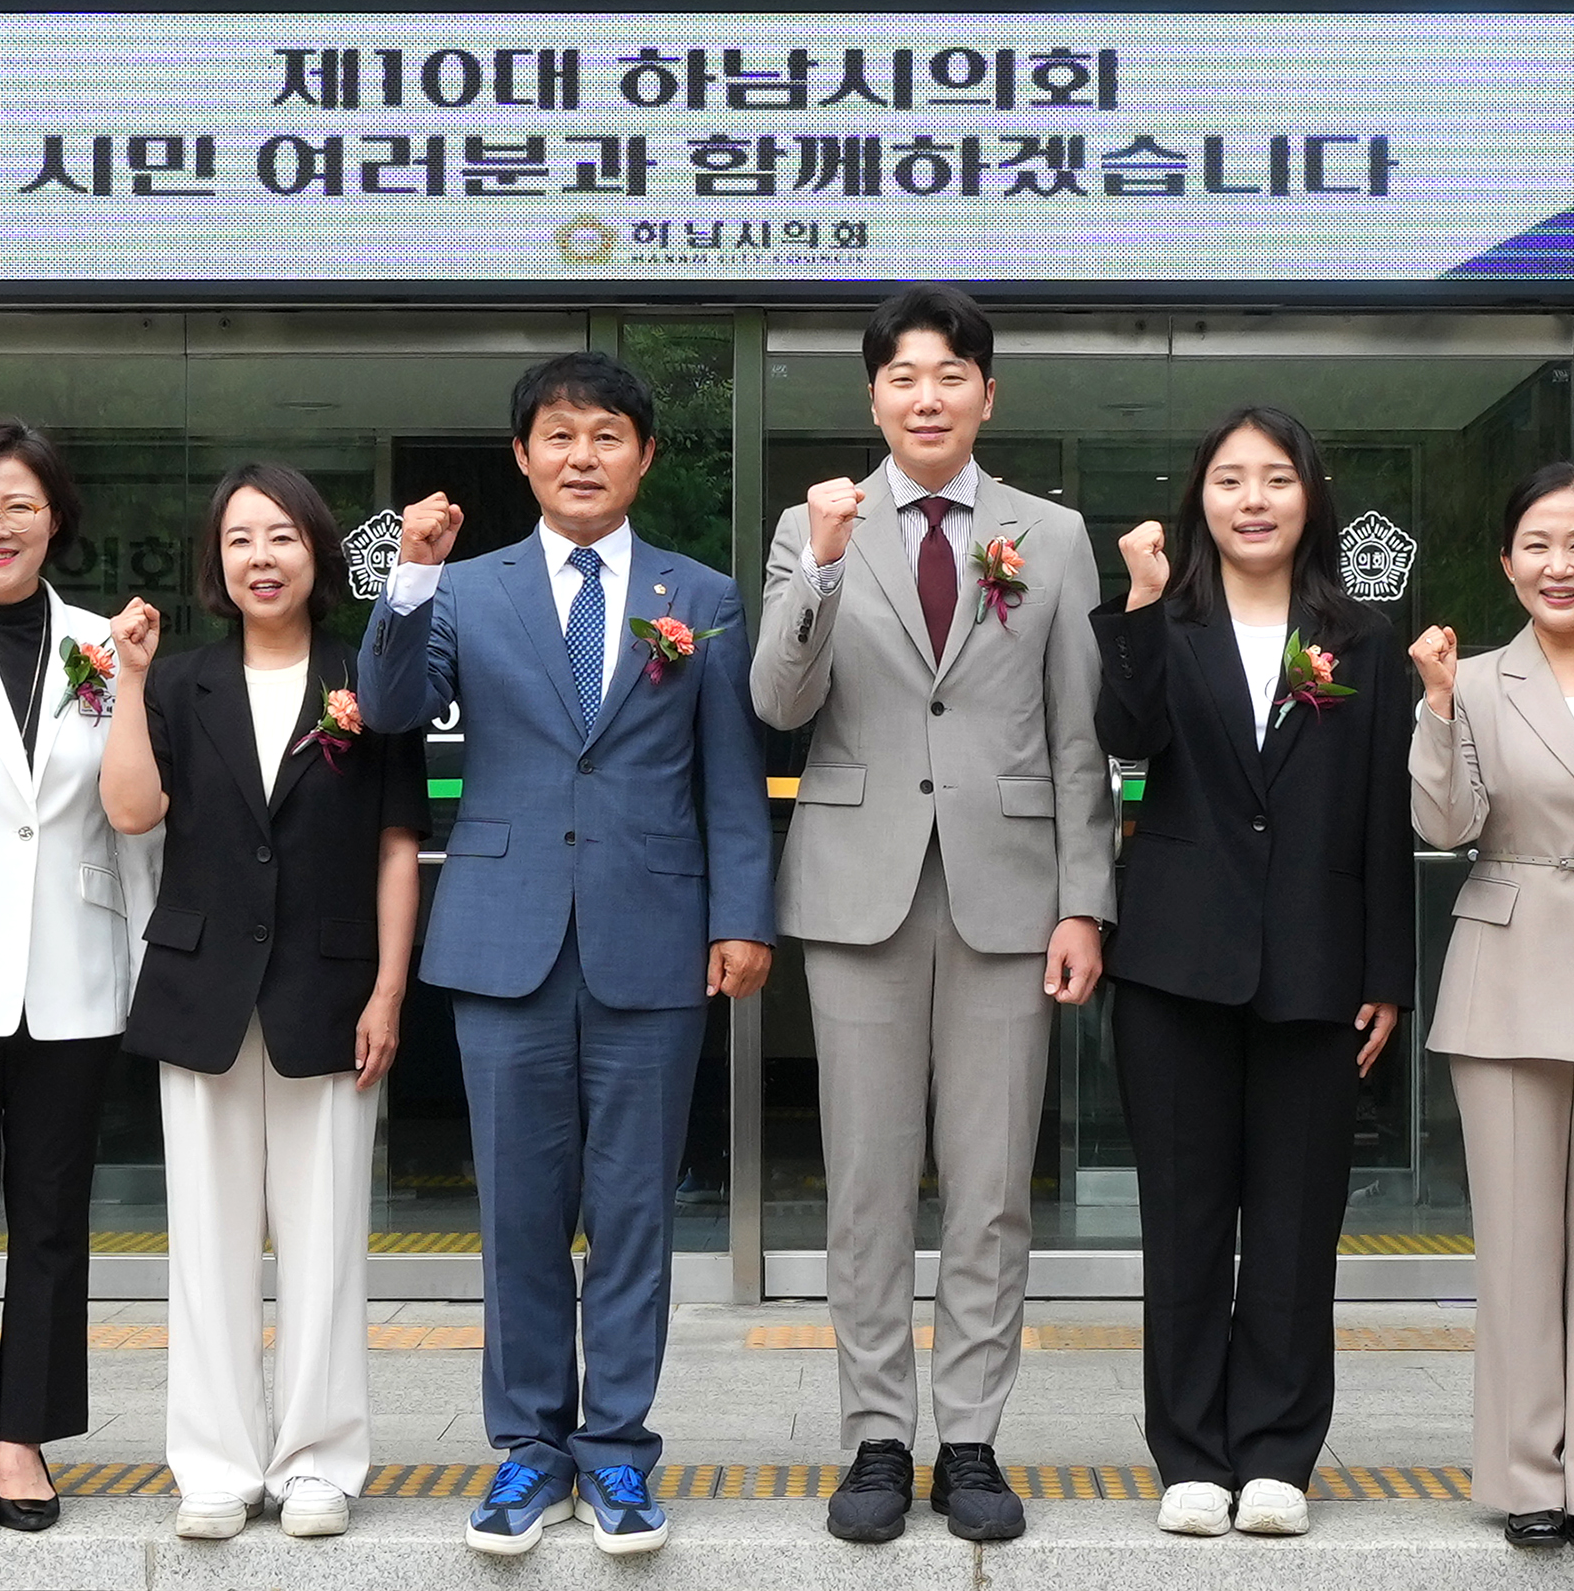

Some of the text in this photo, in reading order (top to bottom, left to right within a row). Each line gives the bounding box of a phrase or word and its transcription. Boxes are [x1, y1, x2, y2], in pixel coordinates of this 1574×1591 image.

[276, 47, 1115, 110] 제10대 하남시의회
[22, 132, 1397, 197] 시민 여러분과 함께하겠습니다
[632, 220, 868, 249] 하남시의회
[1358, 552, 1385, 570] 의회
